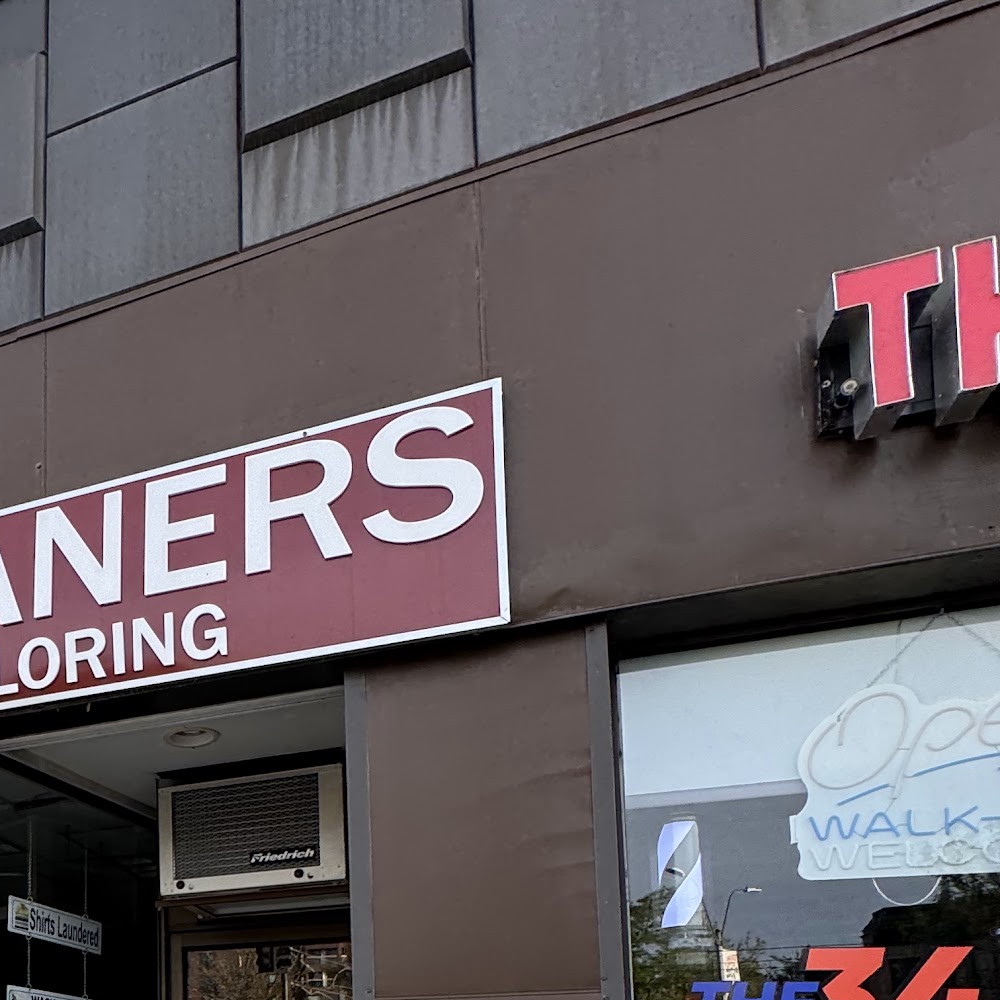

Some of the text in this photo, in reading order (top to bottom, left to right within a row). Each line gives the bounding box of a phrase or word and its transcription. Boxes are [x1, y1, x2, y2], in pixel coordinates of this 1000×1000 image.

[250, 848, 315, 863] Friedrich
[29, 908, 99, 948] Shirts Laundered
